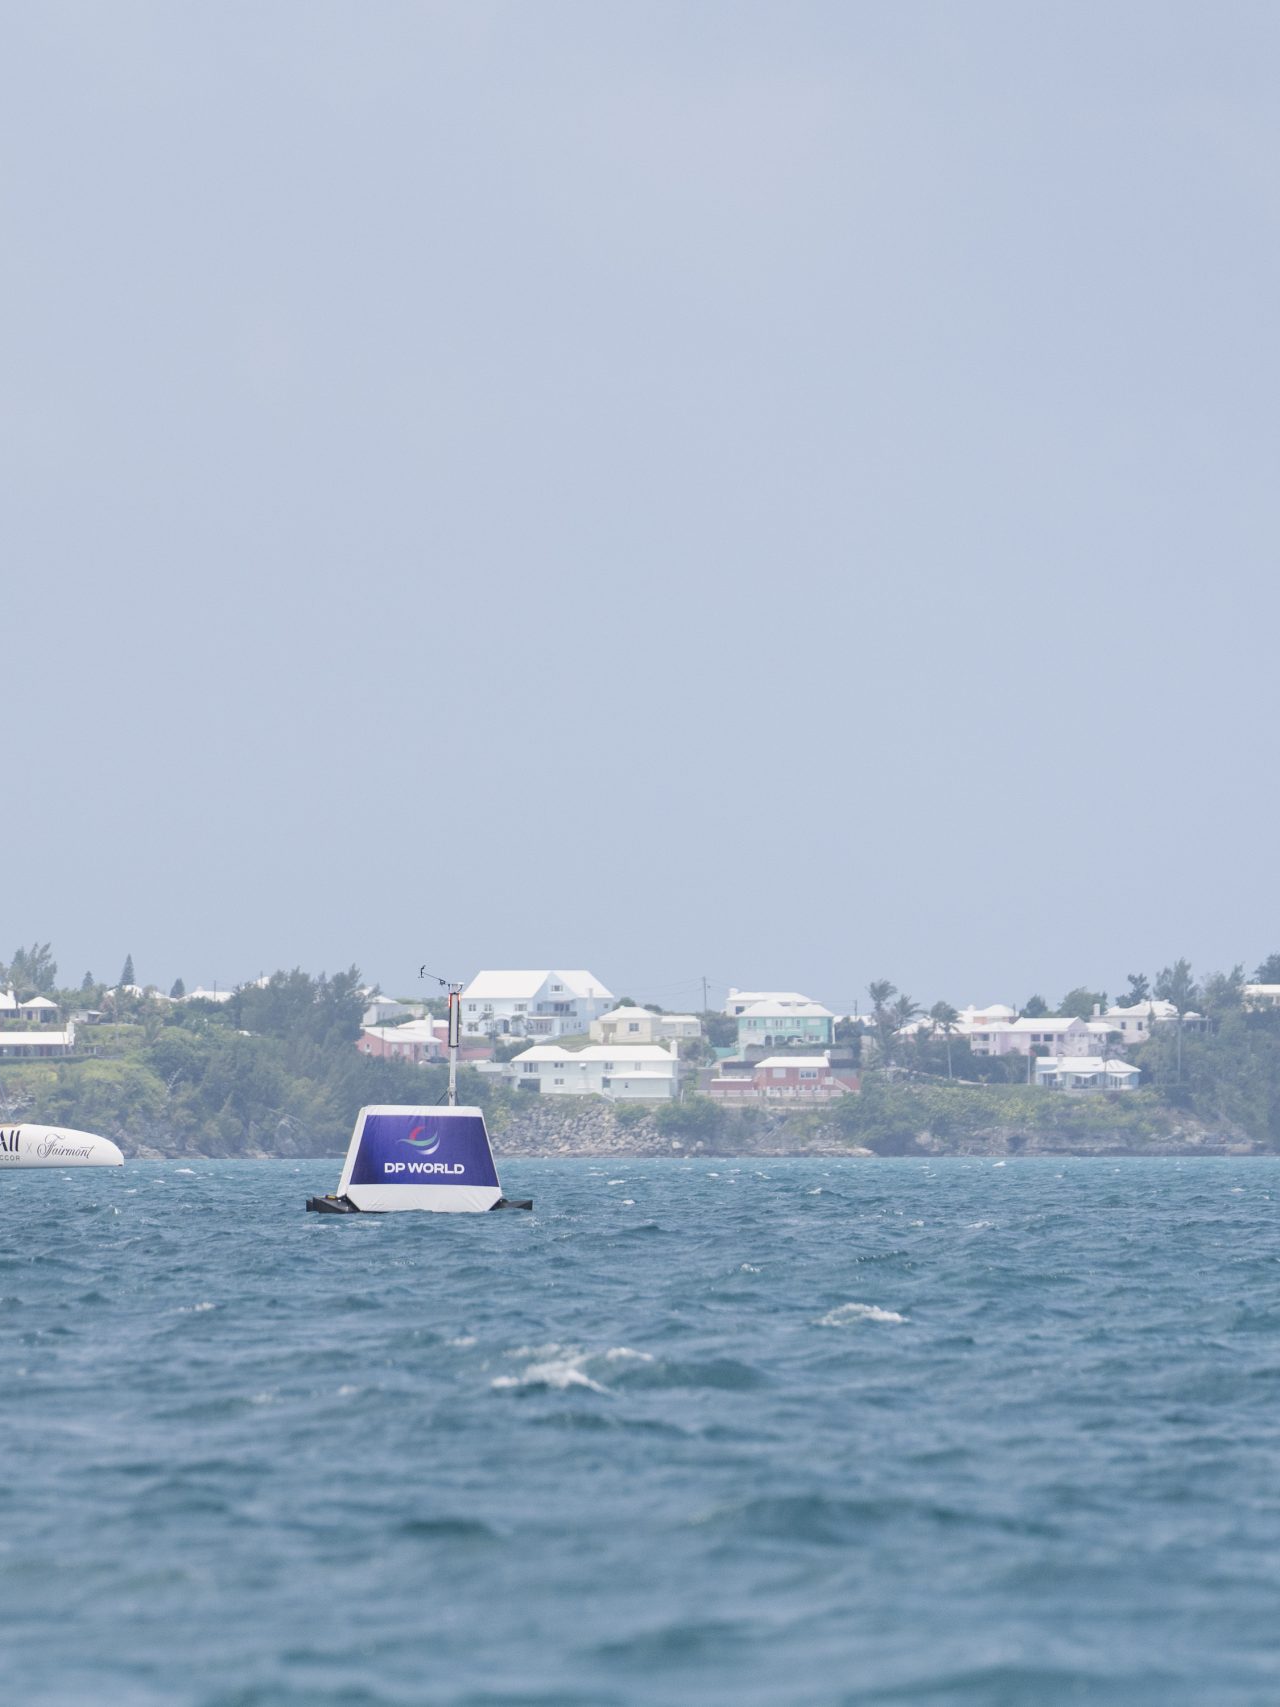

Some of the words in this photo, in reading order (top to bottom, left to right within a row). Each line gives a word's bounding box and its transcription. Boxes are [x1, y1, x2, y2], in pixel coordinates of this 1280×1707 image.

[37, 1133, 95, 1159] Fairmont
[384, 1162, 406, 1174] DP
[407, 1162, 465, 1174] WORLD
